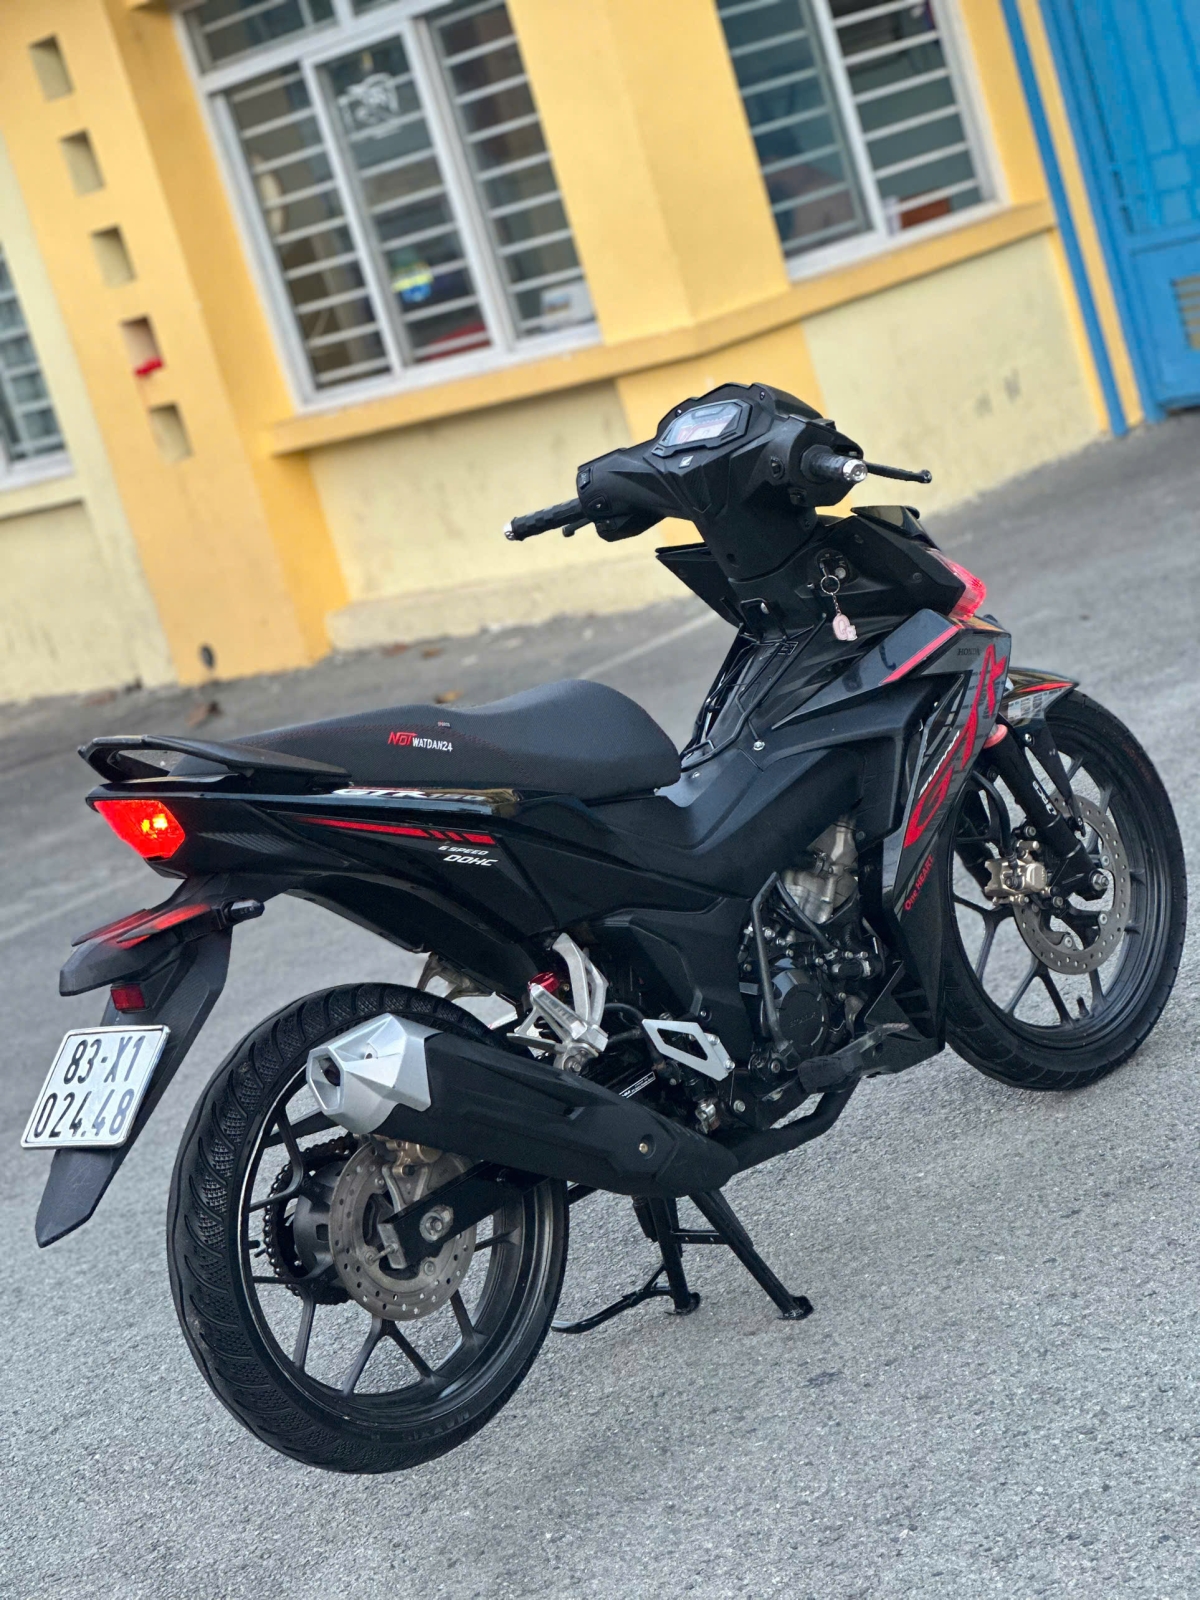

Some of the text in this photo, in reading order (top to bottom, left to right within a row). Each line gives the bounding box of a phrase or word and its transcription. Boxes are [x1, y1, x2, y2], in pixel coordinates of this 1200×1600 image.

[443, 854, 498, 866] DOHC
[448, 846, 489, 856] SPEED
[915, 854, 934, 889] HEART
[63, 1035, 146, 1084] 83-X1
[33, 1088, 135, 1138] 024.48
